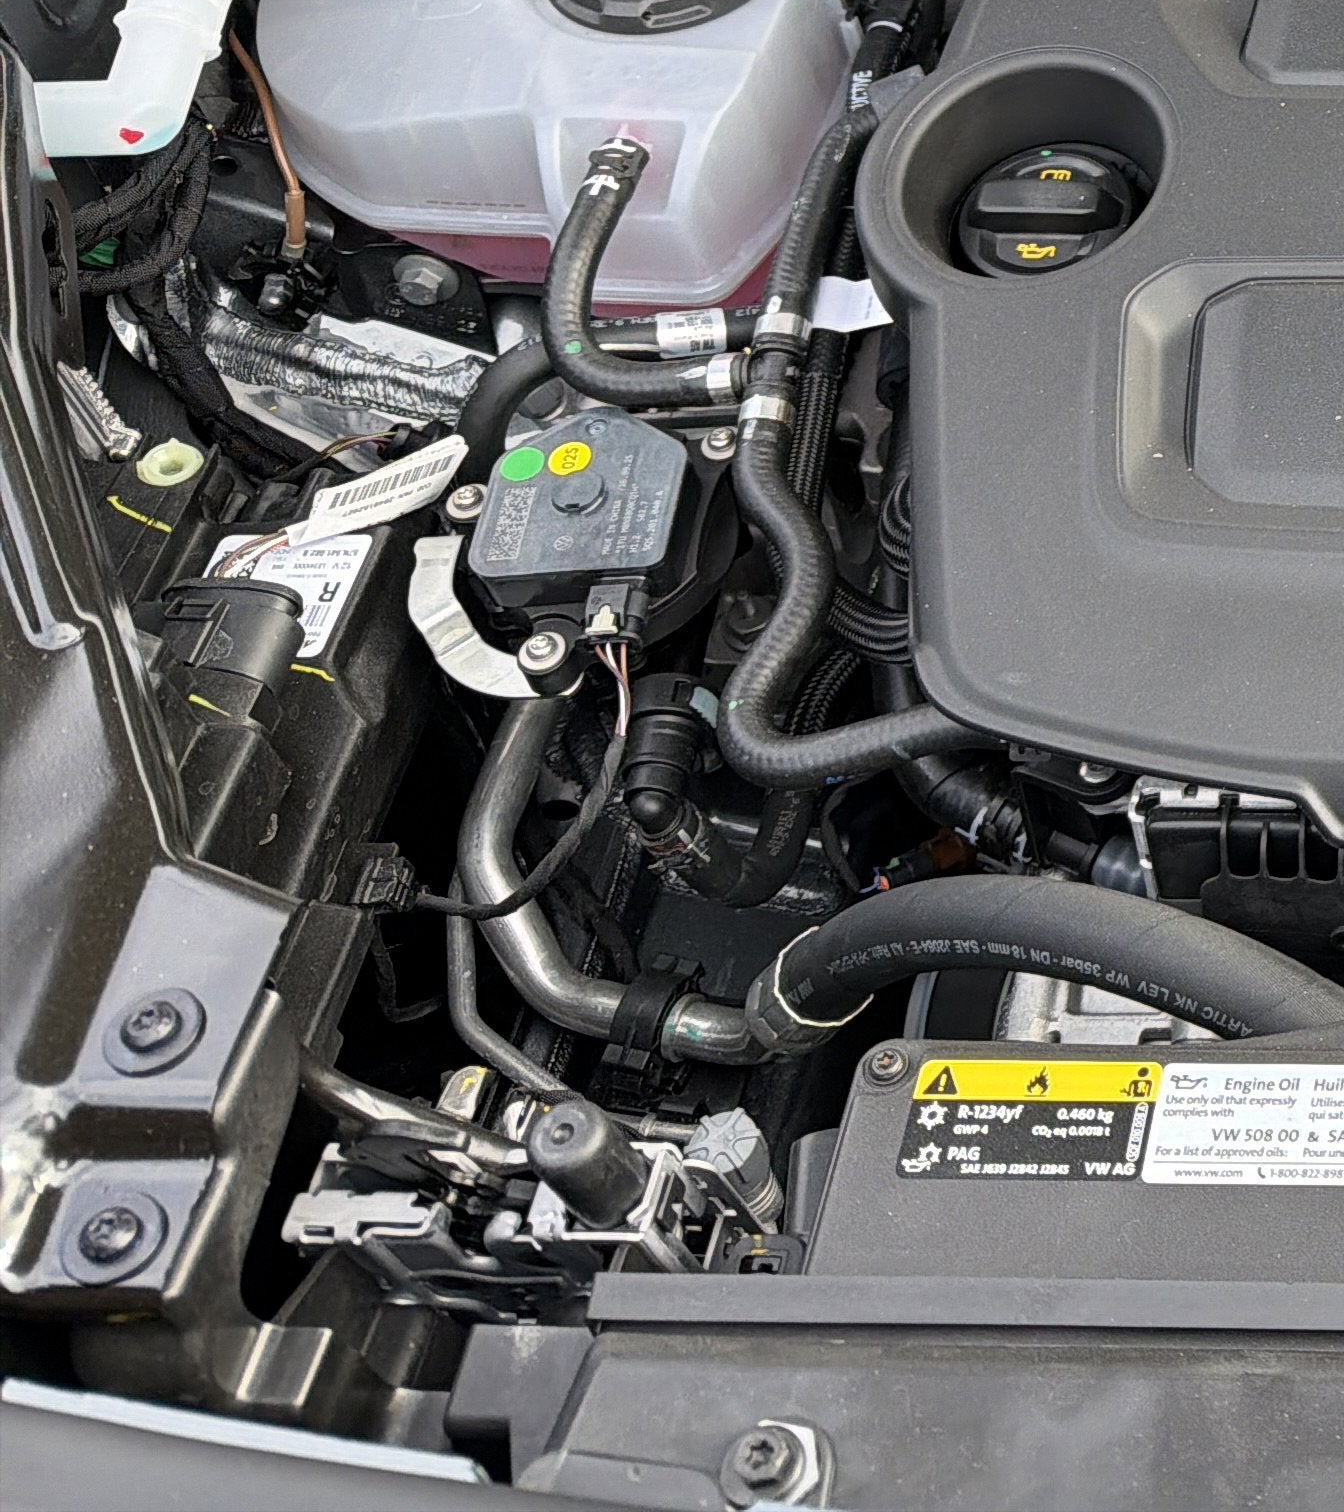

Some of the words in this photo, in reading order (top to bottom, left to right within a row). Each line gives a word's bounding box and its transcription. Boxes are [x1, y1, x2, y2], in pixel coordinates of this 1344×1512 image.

[318, 582, 341, 603] R
[954, 939, 981, 954] SAE
[1030, 949, 1051, 965] DN
[1060, 955, 1101, 977] 35bar
[1105, 970, 1131, 989] WP
[1137, 980, 1170, 1002] LEV
[1173, 992, 1198, 1013] NK
[1201, 1006, 1253, 1037] ARTIC
[1224, 1077, 1275, 1094] Engine
[1279, 1078, 1300, 1091] Oil
[1166, 1096, 1185, 1105] Use
[1187, 1095, 1209, 1107] only
[1211, 1095, 1223, 1105] oil
[1226, 1096, 1247, 1105] that
[1249, 1096, 1297, 1108] expressly
[957, 1104, 1024, 1123] R-1234yf
[1056, 1107, 1096, 1121] 0.460
[1097, 1107, 1114, 1124] kg
[1163, 1108, 1209, 1119] complies
[1211, 1108, 1235, 1117] with
[1308, 1111, 1326, 1122] qui
[953, 1125, 980, 1135] GWP
[981, 1126, 989, 1135] 4
[1053, 1128, 1067, 1138] eq
[1212, 1128, 1241, 1142] VW
[1244, 1128, 1273, 1142] 508
[1277, 1129, 1300, 1142] 00
[1307, 1131, 1319, 1142] &
[946, 1147, 982, 1161] PAG
[1155, 1146, 1172, 1156] For
[1183, 1146, 1199, 1156] list
[1201, 1146, 1214, 1156] of
[1214, 1147, 1265, 1159] approved
[1303, 1148, 1327, 1158] Pour
[960, 1164, 980, 1174] SAE
[1084, 1162, 1112, 1175] VW
[1113, 1163, 1137, 1176] AG
[1174, 1169, 1244, 1178] www.vw.com
